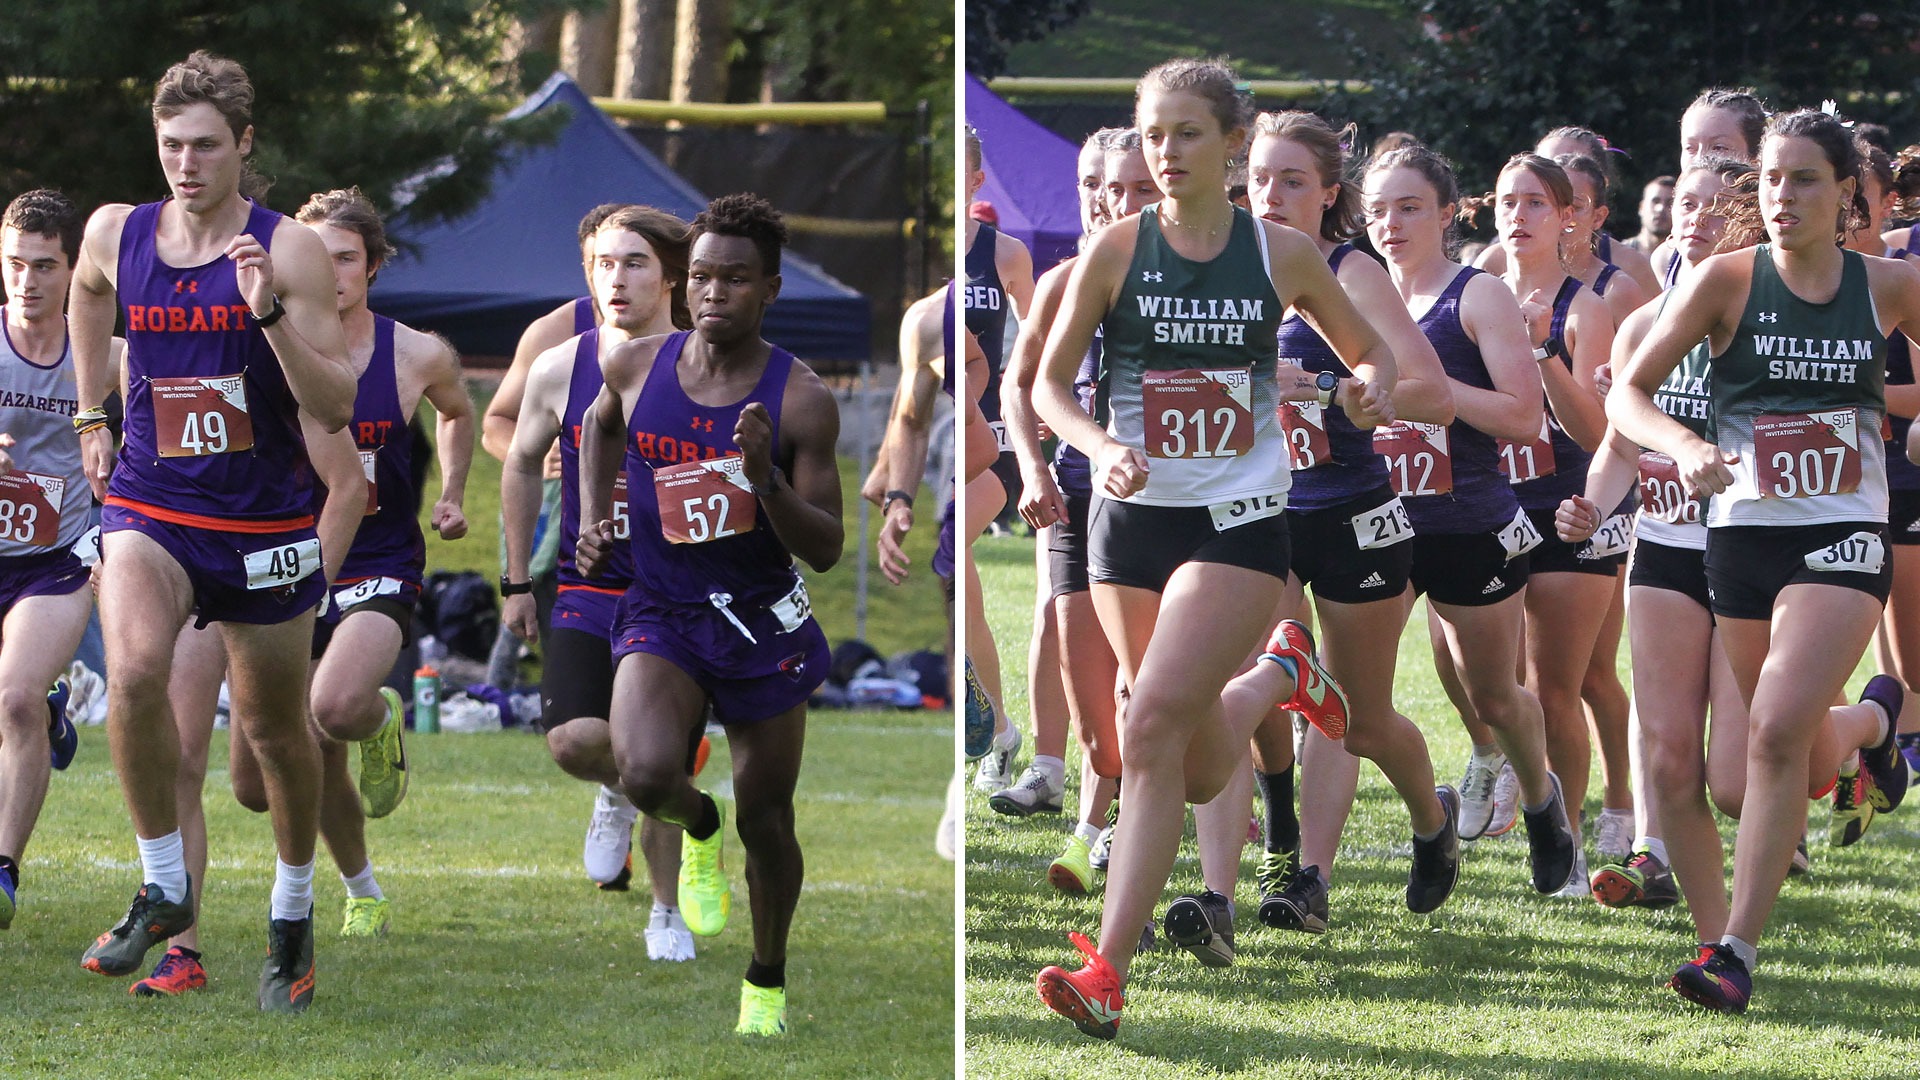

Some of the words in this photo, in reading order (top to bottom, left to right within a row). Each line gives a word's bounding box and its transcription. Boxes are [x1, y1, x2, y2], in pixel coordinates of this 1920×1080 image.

[128, 304, 251, 333] HOBART
[1136, 295, 1264, 321] WILLIAM
[1154, 322, 1245, 345] SMITH
[1753, 335, 1873, 360] WILLIAM
[1226, 373, 1248, 388] SJF
[1769, 360, 1857, 384] SMITH
[221, 379, 242, 394] SJF
[0, 390, 78, 417] AZARETH
[180, 411, 228, 455] 49
[1161, 407, 1237, 458] 312
[1755, 423, 1775, 431] FISHER
[1779, 420, 1814, 428] RODENBECK
[1765, 429, 1805, 437] INVITATIONAL
[1832, 414, 1854, 429] SJF
[664, 478, 700, 488] INVITATIONAL
[1772, 446, 1846, 498] 307
[683, 493, 736, 543] 52
[268, 546, 301, 580] 49
[1822, 538, 1869, 564] 307
[355, 576, 383, 598] 57
[1359, 579, 1386, 589] adidas
